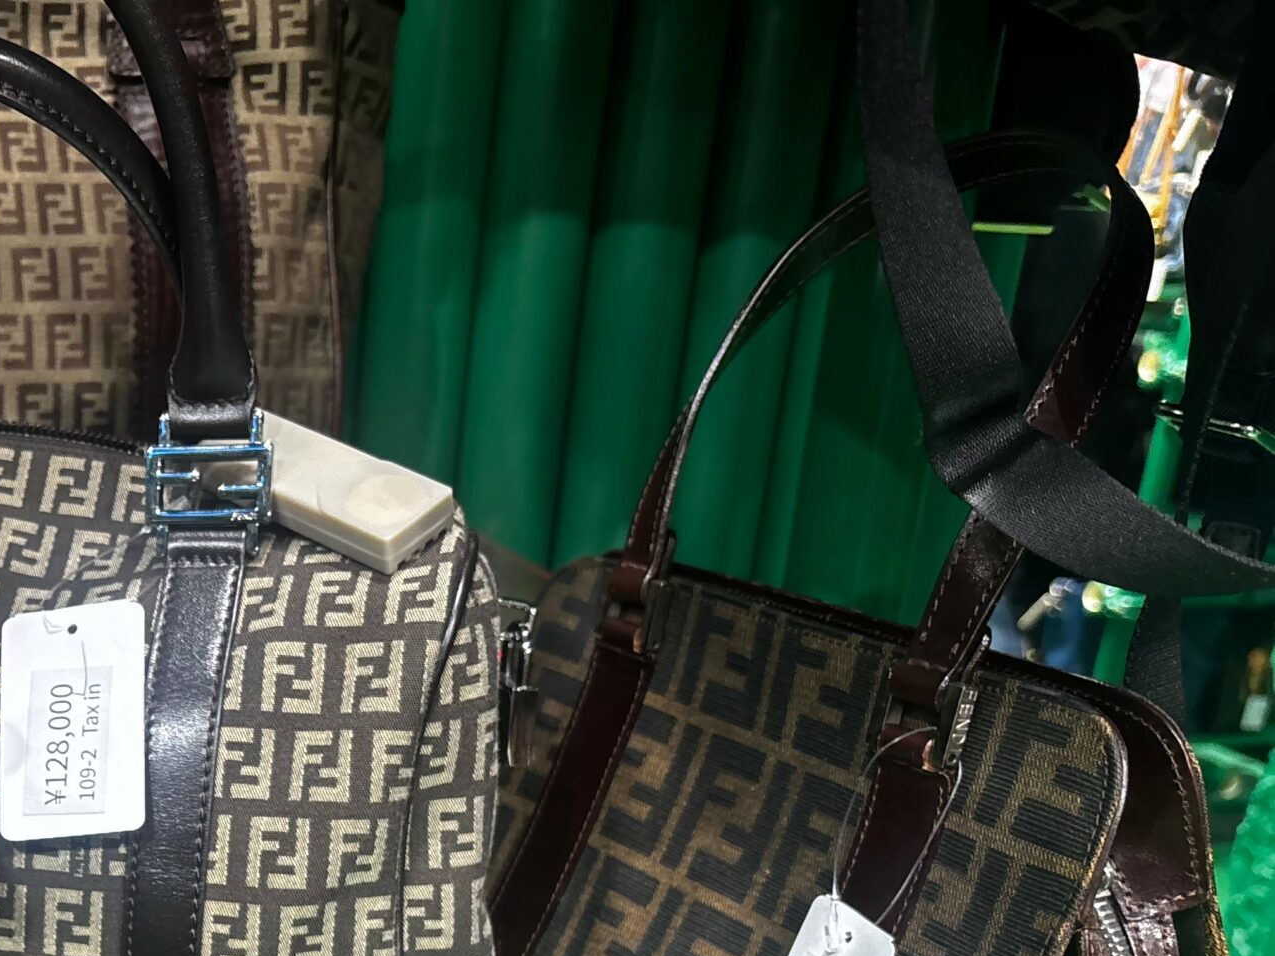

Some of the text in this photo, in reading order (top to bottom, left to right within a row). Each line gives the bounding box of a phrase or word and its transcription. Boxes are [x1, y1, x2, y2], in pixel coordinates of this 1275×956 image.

[44, 683, 75, 806] ¥128,000
[79, 683, 102, 801] 109-2 Tax in
[948, 690, 978, 753] FENDI
